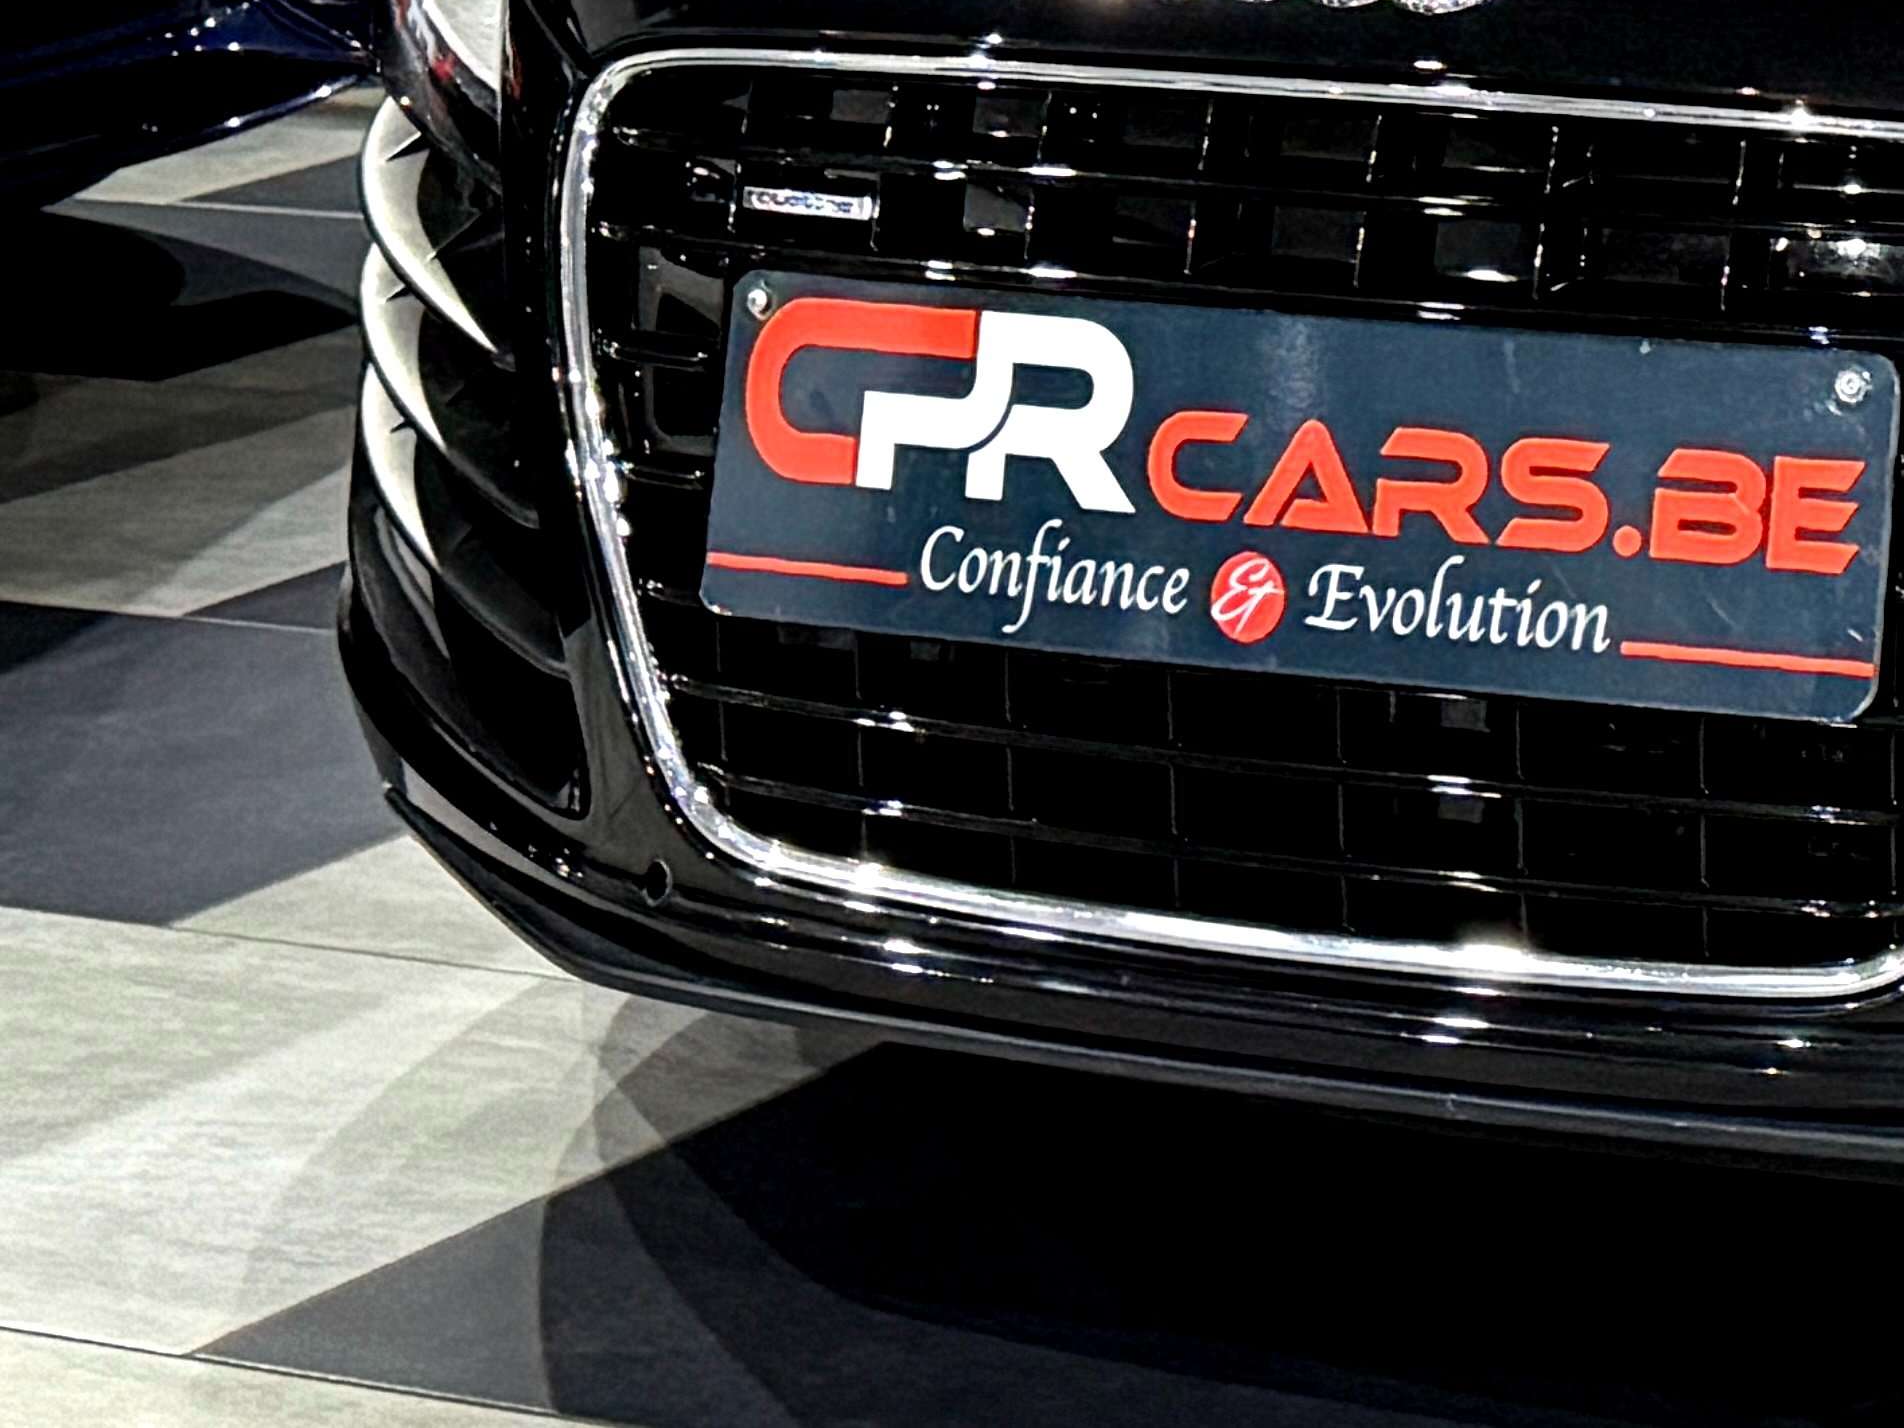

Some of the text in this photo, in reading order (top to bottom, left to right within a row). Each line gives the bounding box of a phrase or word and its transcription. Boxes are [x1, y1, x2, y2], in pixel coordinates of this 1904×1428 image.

[744, 296, 1866, 576] CPR CARS.BE
[920, 518, 1190, 633] Confiance
[1304, 555, 1611, 653] Evolution
